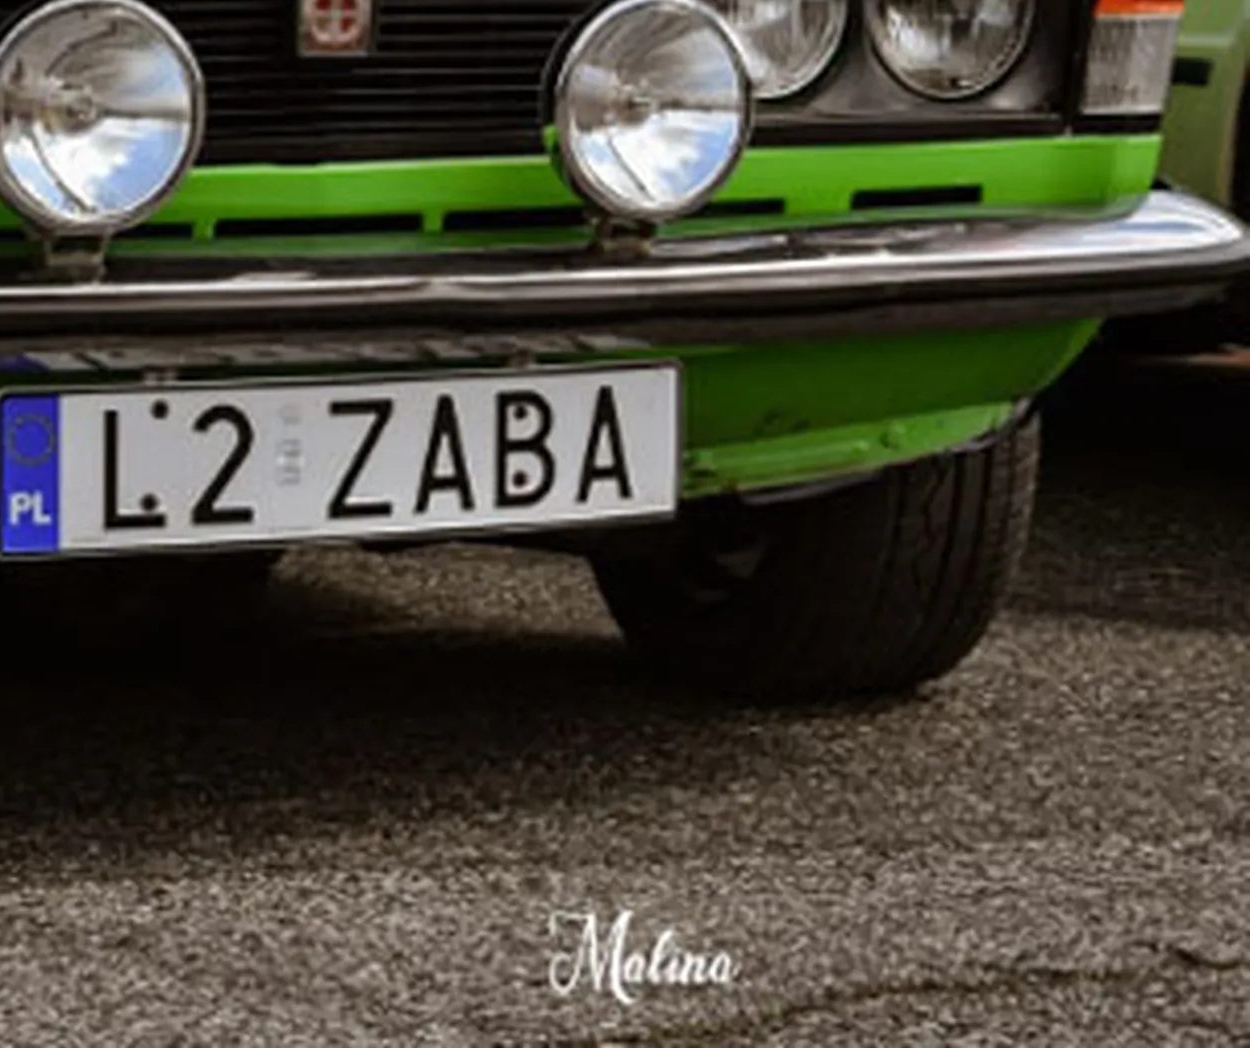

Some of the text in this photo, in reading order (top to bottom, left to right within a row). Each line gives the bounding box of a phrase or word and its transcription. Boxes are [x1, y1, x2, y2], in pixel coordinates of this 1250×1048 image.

[103, 384, 633, 532] L2 ZABA
[8, 492, 52, 526] PL
